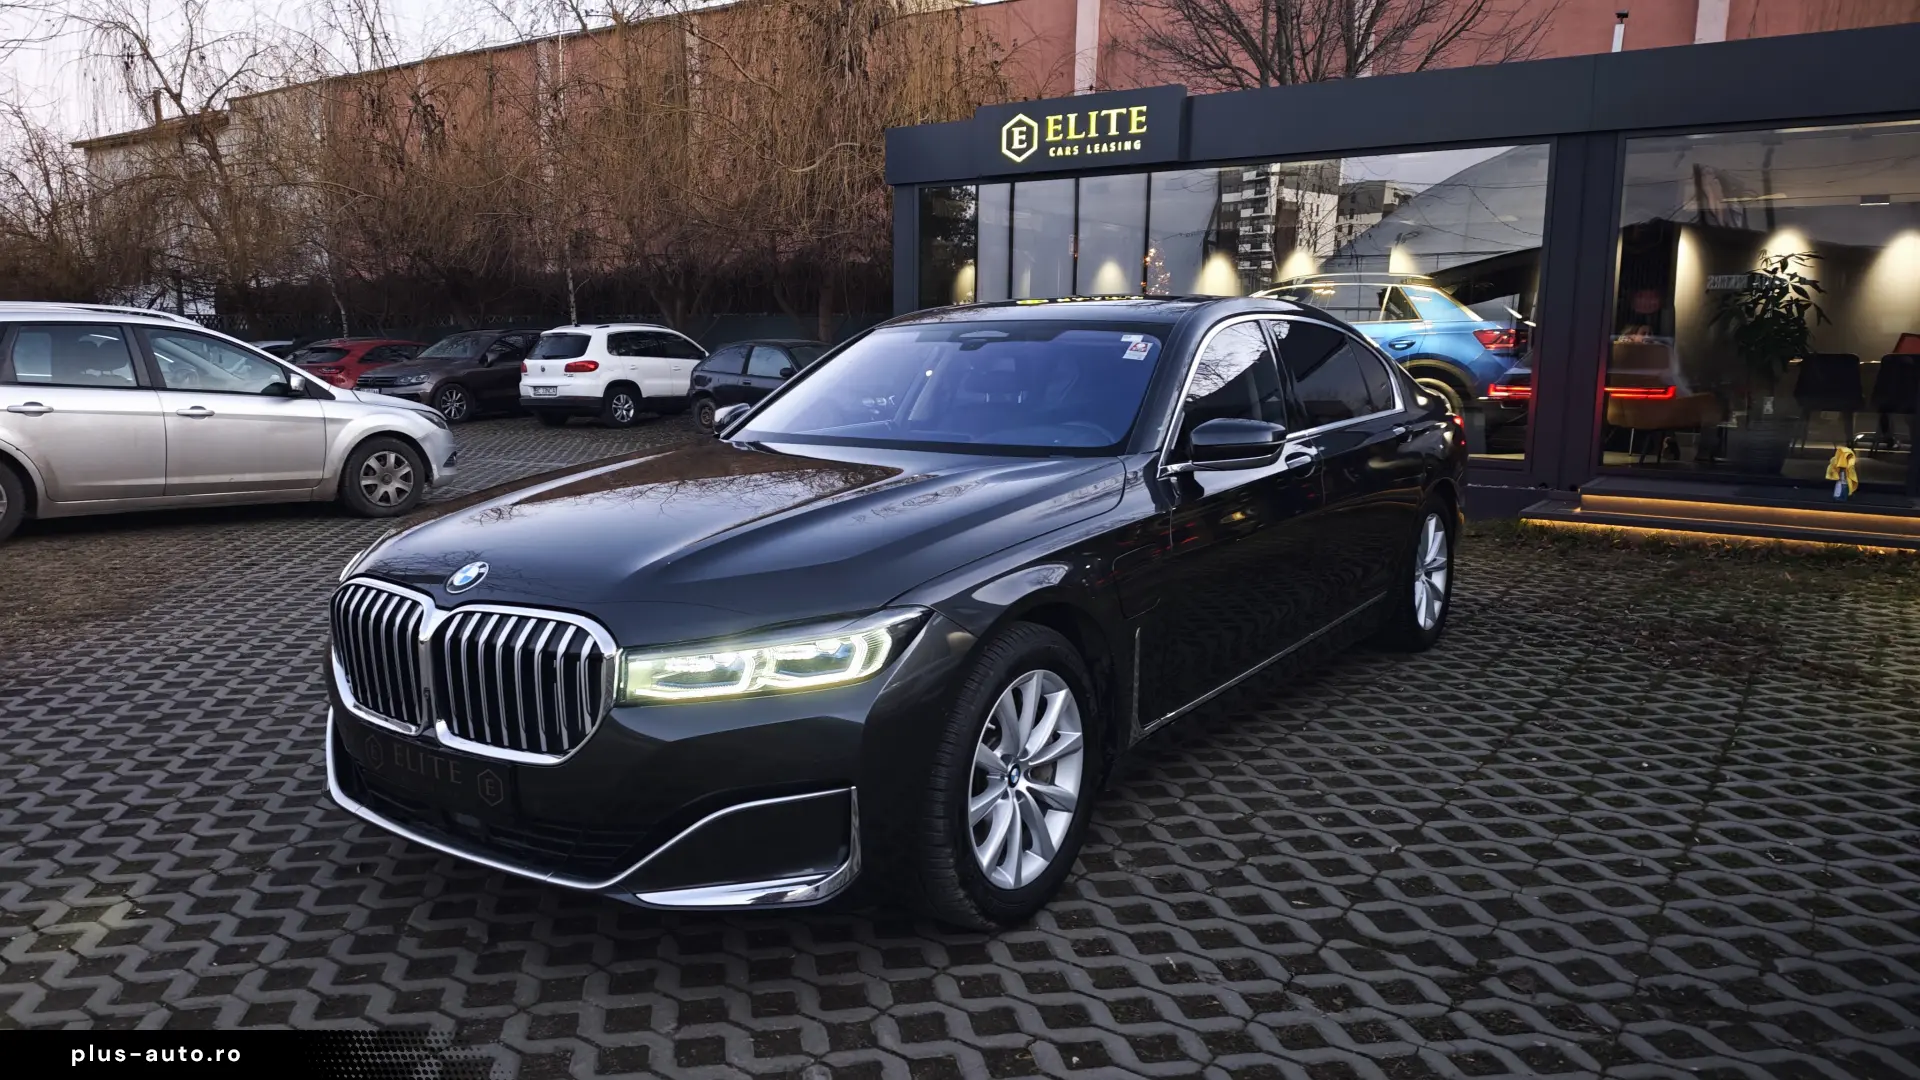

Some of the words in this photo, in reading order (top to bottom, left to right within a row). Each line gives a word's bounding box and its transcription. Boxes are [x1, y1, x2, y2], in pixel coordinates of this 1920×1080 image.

[1011, 126, 1028, 150] E
[1045, 105, 1148, 142] ELITE
[1048, 145, 1079, 157] CARS
[1086, 139, 1142, 155] LEASING
[393, 742, 462, 784] ELITE
